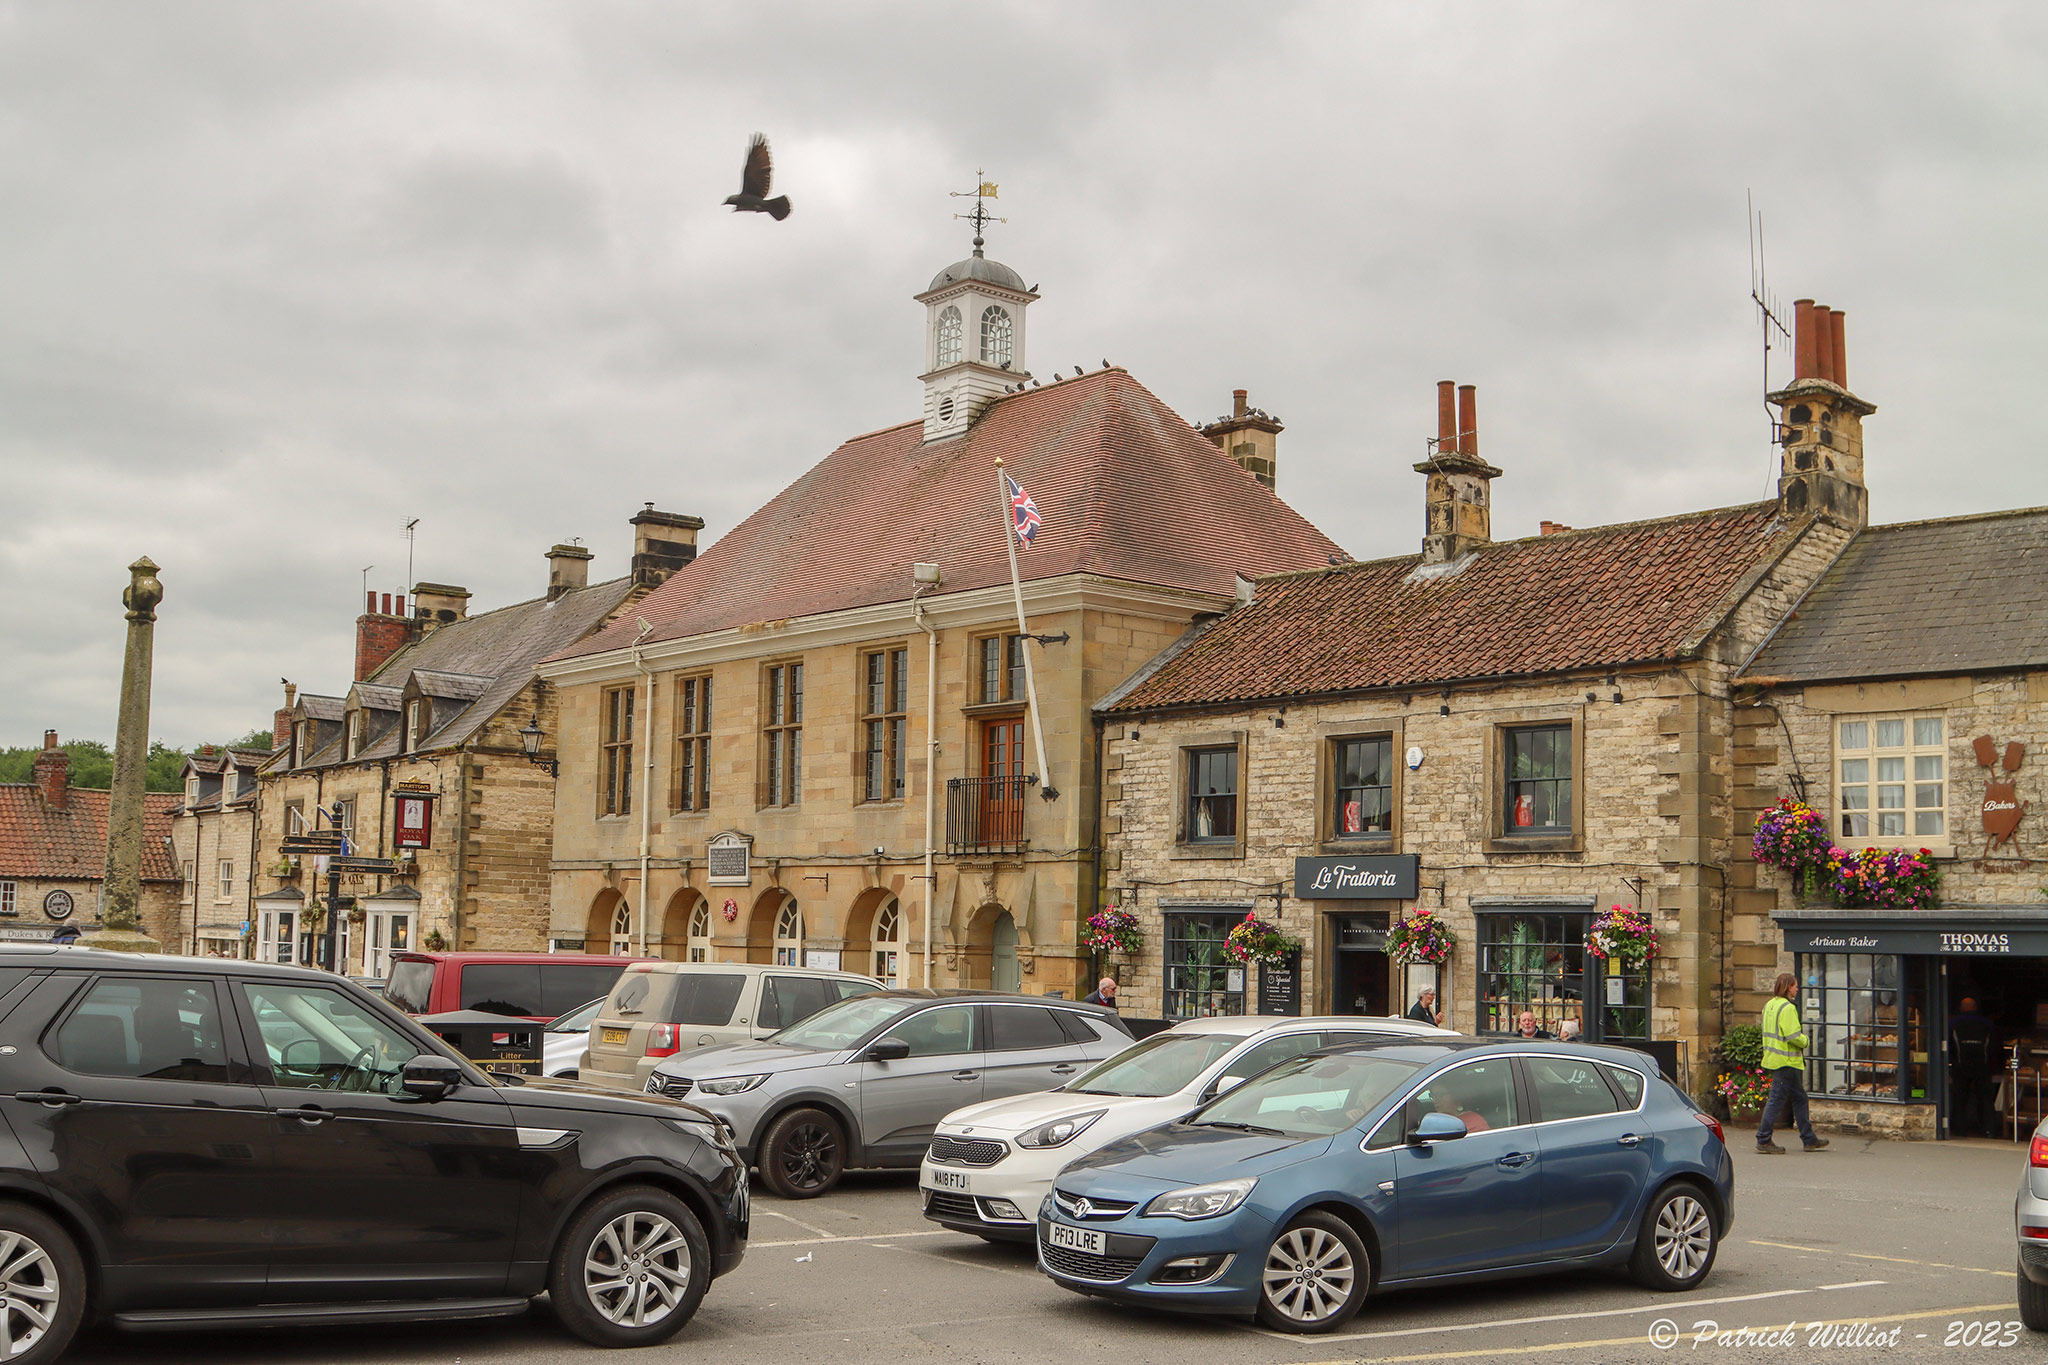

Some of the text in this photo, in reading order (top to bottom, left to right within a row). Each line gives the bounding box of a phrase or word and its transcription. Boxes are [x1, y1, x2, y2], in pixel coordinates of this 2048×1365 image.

[1983, 800, 2016, 811] Bakers
[1310, 864, 1397, 889] La Trattoria
[8, 930, 33, 938] Dukes
[1940, 933, 2009, 946] THOMAS
[1809, 935, 1879, 947] Artisan Baker
[1952, 945, 2010, 953] BAKER
[934, 1171, 965, 1189] MA18 FTJ
[1054, 1226, 1098, 1250] PF13 LRE
